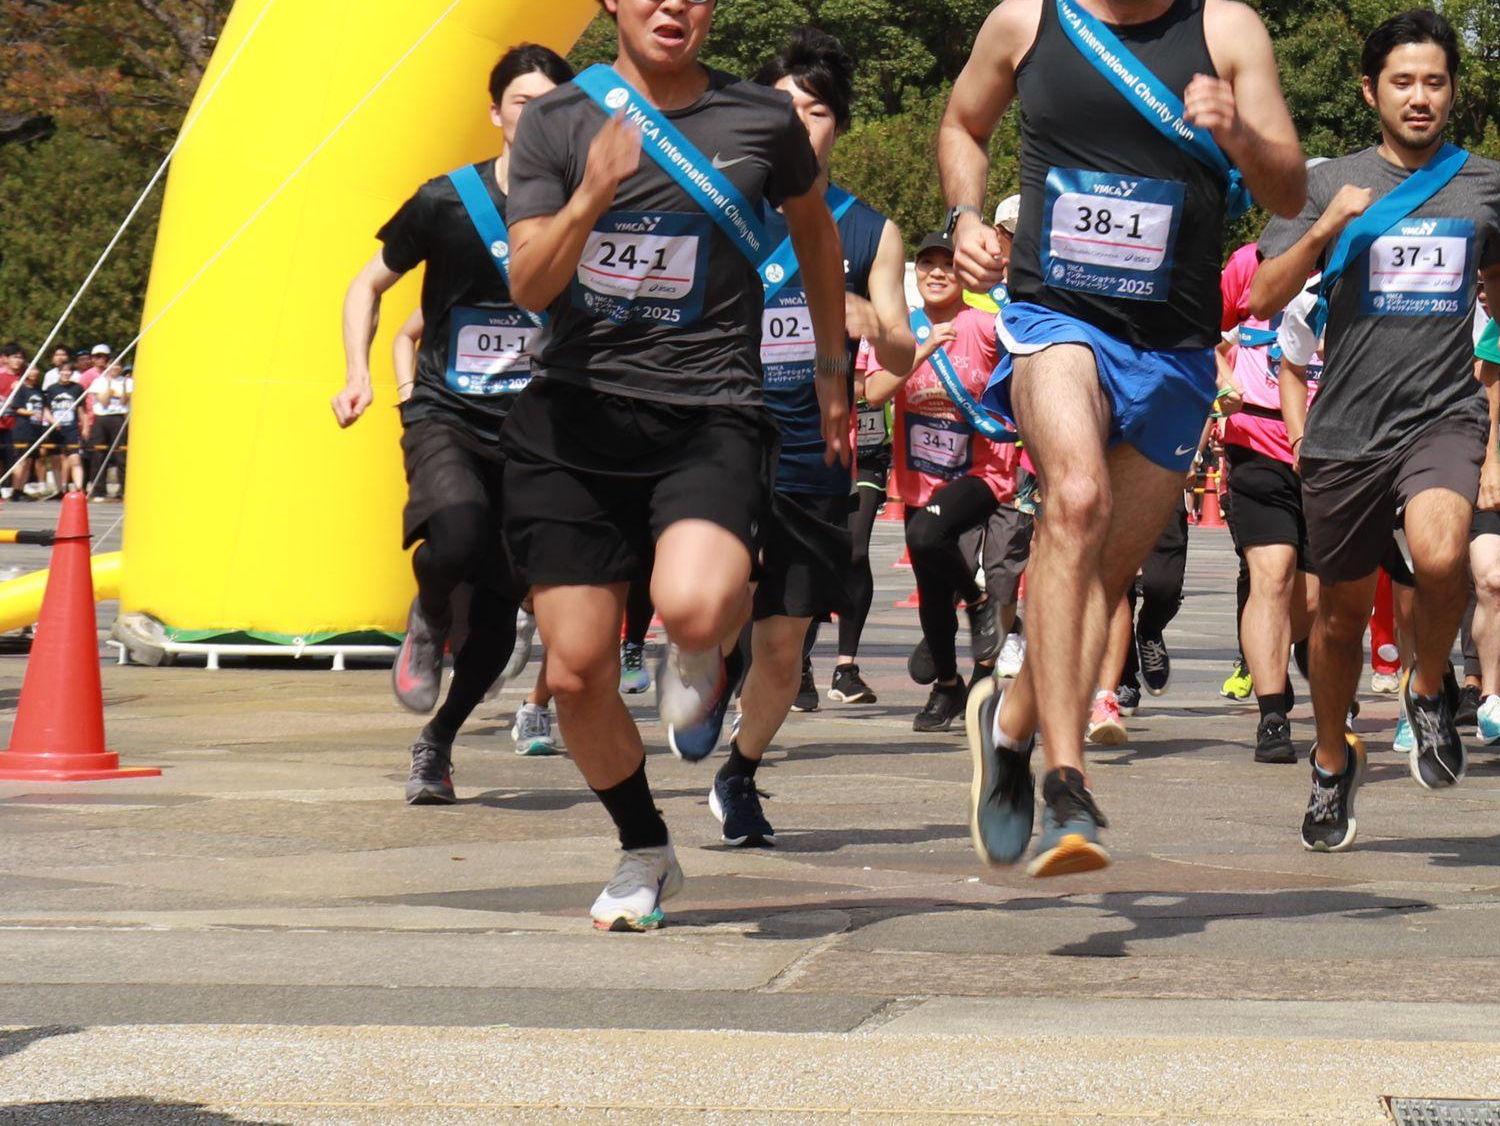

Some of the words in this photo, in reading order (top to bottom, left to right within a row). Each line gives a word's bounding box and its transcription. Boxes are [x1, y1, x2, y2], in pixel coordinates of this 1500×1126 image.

[1077, 24, 1140, 88] International
[1134, 82, 1174, 123] Charity
[1171, 117, 1195, 142] Run
[624, 102, 661, 141] YMCA
[656, 135, 730, 210] International
[744, 231, 761, 253] Run
[1093, 183, 1122, 197] YMCA
[614, 221, 646, 232] YMCA
[1074, 206, 1143, 240] 38-1
[599, 240, 668, 271] 24-1
[1391, 246, 1446, 268] 37-1
[1116, 277, 1154, 295] 2025
[778, 297, 802, 306] YMCA
[1430, 298, 1459, 313] 2025
[641, 305, 681, 322] 2025
[477, 333, 526, 354] 01-1
[922, 431, 956, 453] 34-1
